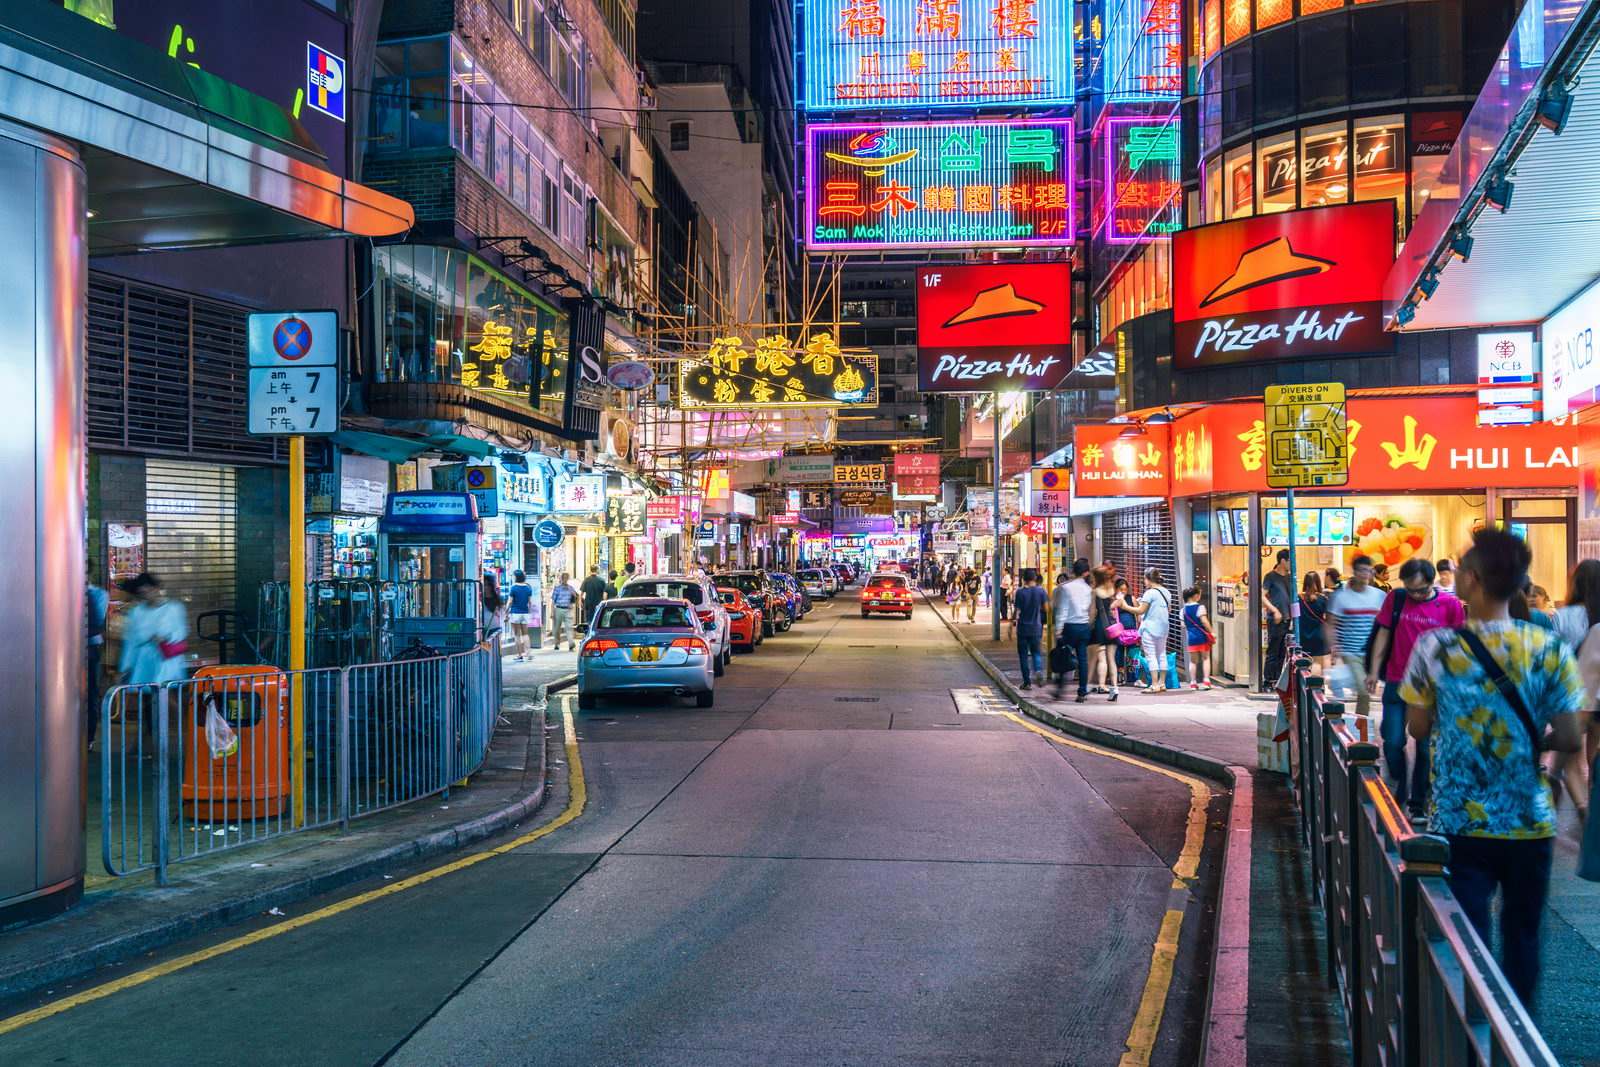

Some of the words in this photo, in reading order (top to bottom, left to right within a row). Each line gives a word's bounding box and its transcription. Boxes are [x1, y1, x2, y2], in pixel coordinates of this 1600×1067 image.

[840, 0, 1038, 39] 福滿樓
[858, 48, 1020, 77] 川粵名菜
[836, 82, 920, 99] SZECHUEN
[940, 78, 1044, 97] RESTAURANT
[941, 129, 1058, 172] 삼목
[815, 225, 847, 240] Sam
[854, 224, 885, 238] Mok
[891, 223, 942, 238] Korean
[950, 222, 1033, 237] Restaurant
[1039, 220, 1067, 235] 2/F
[923, 274, 942, 287] 1/F
[1194, 318, 1281, 359] Pizza
[1284, 310, 1365, 345] Hut
[932, 354, 1003, 383] Pizza
[1002, 352, 1061, 378] Hut
[1490, 361, 1522, 371] NCB
[266, 382, 292, 394] 上午
[271, 371, 287, 379] am
[306, 372, 320, 394] 7
[266, 418, 292, 430] 下午
[271, 406, 287, 415] pm
[306, 407, 320, 429] 7
[1081, 441, 1162, 468] 許山
[1450, 447, 1509, 469] HUI
[836, 466, 882, 481] 금성식당
[1082, 471, 1100, 480] HUI
[1103, 471, 1125, 480] LAU
[1042, 493, 1059, 501] End
[1038, 503, 1062, 513] 終止
[1031, 520, 1044, 532] 24
[1052, 520, 1067, 530] TM
